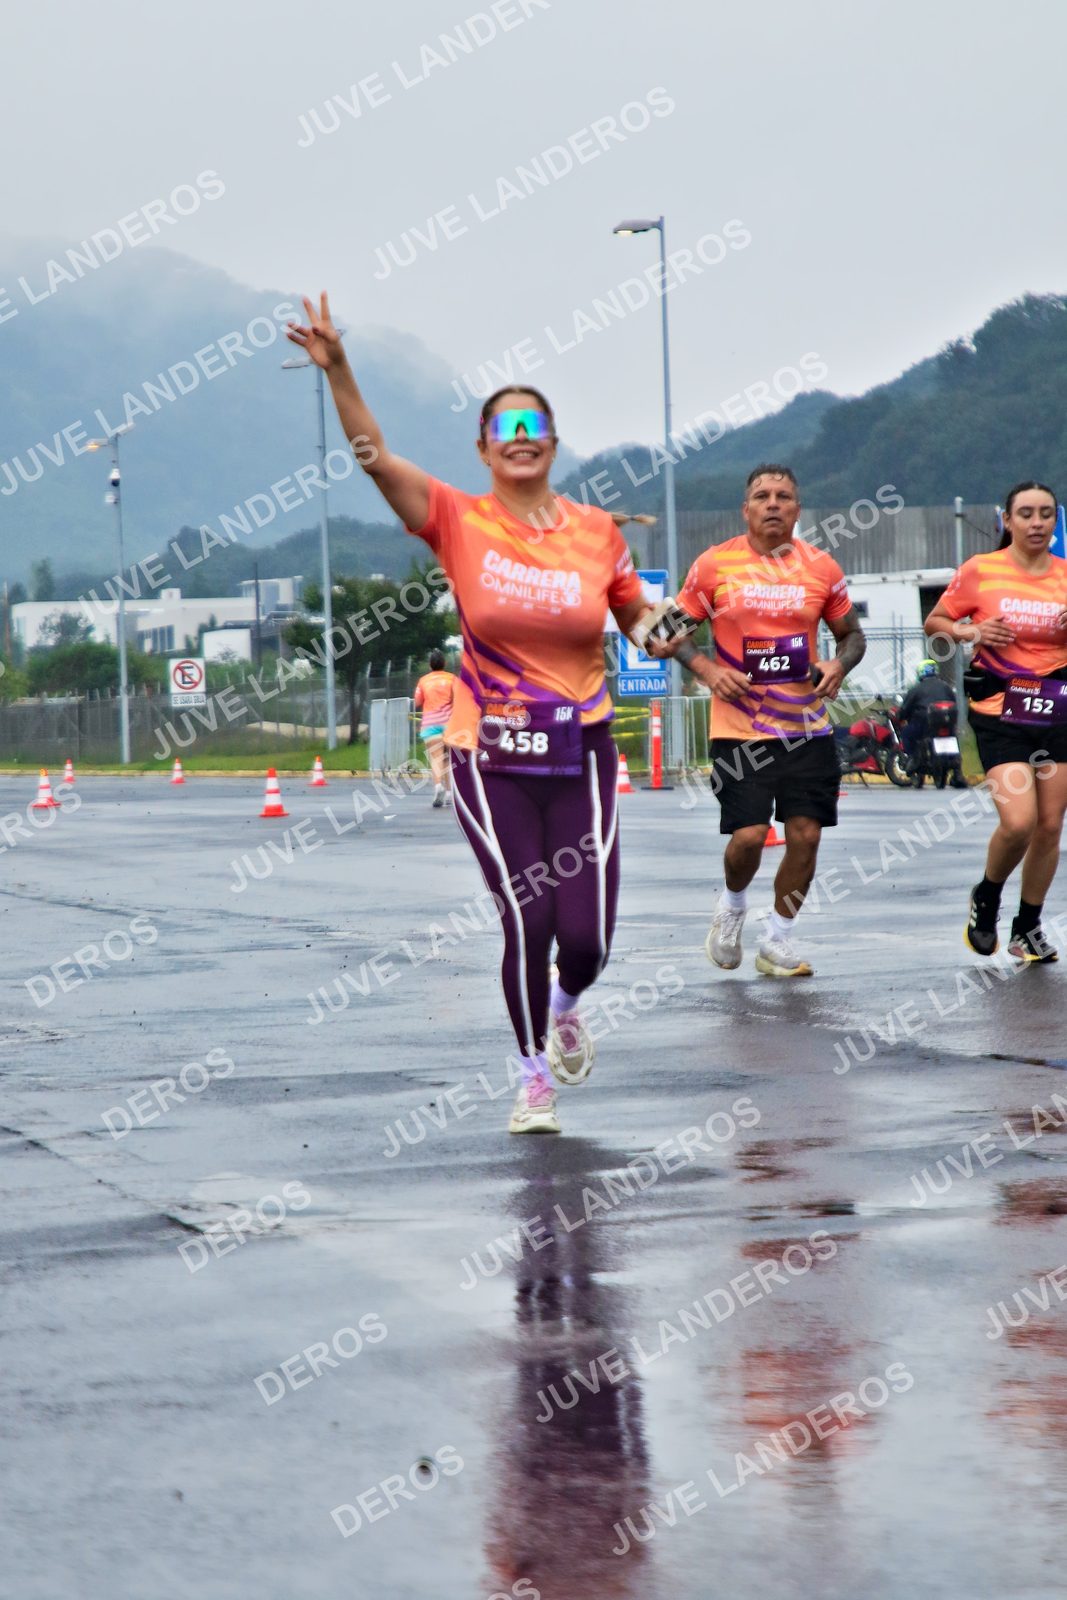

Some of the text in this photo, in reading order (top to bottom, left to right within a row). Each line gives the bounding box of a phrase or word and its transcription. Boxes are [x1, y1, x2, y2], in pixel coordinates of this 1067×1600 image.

[482, 549, 581, 595] CARRERA
[480, 572, 561, 604] OMNILIFE
[743, 584, 806, 602] CARRERA
[744, 598, 791, 612] OMNILIFE
[758, 655, 790, 671] 462
[620, 677, 668, 693] ENTRADA
[553, 705, 573, 721] 15K
[1022, 696, 1054, 715] 152
[499, 729, 549, 755] 458
